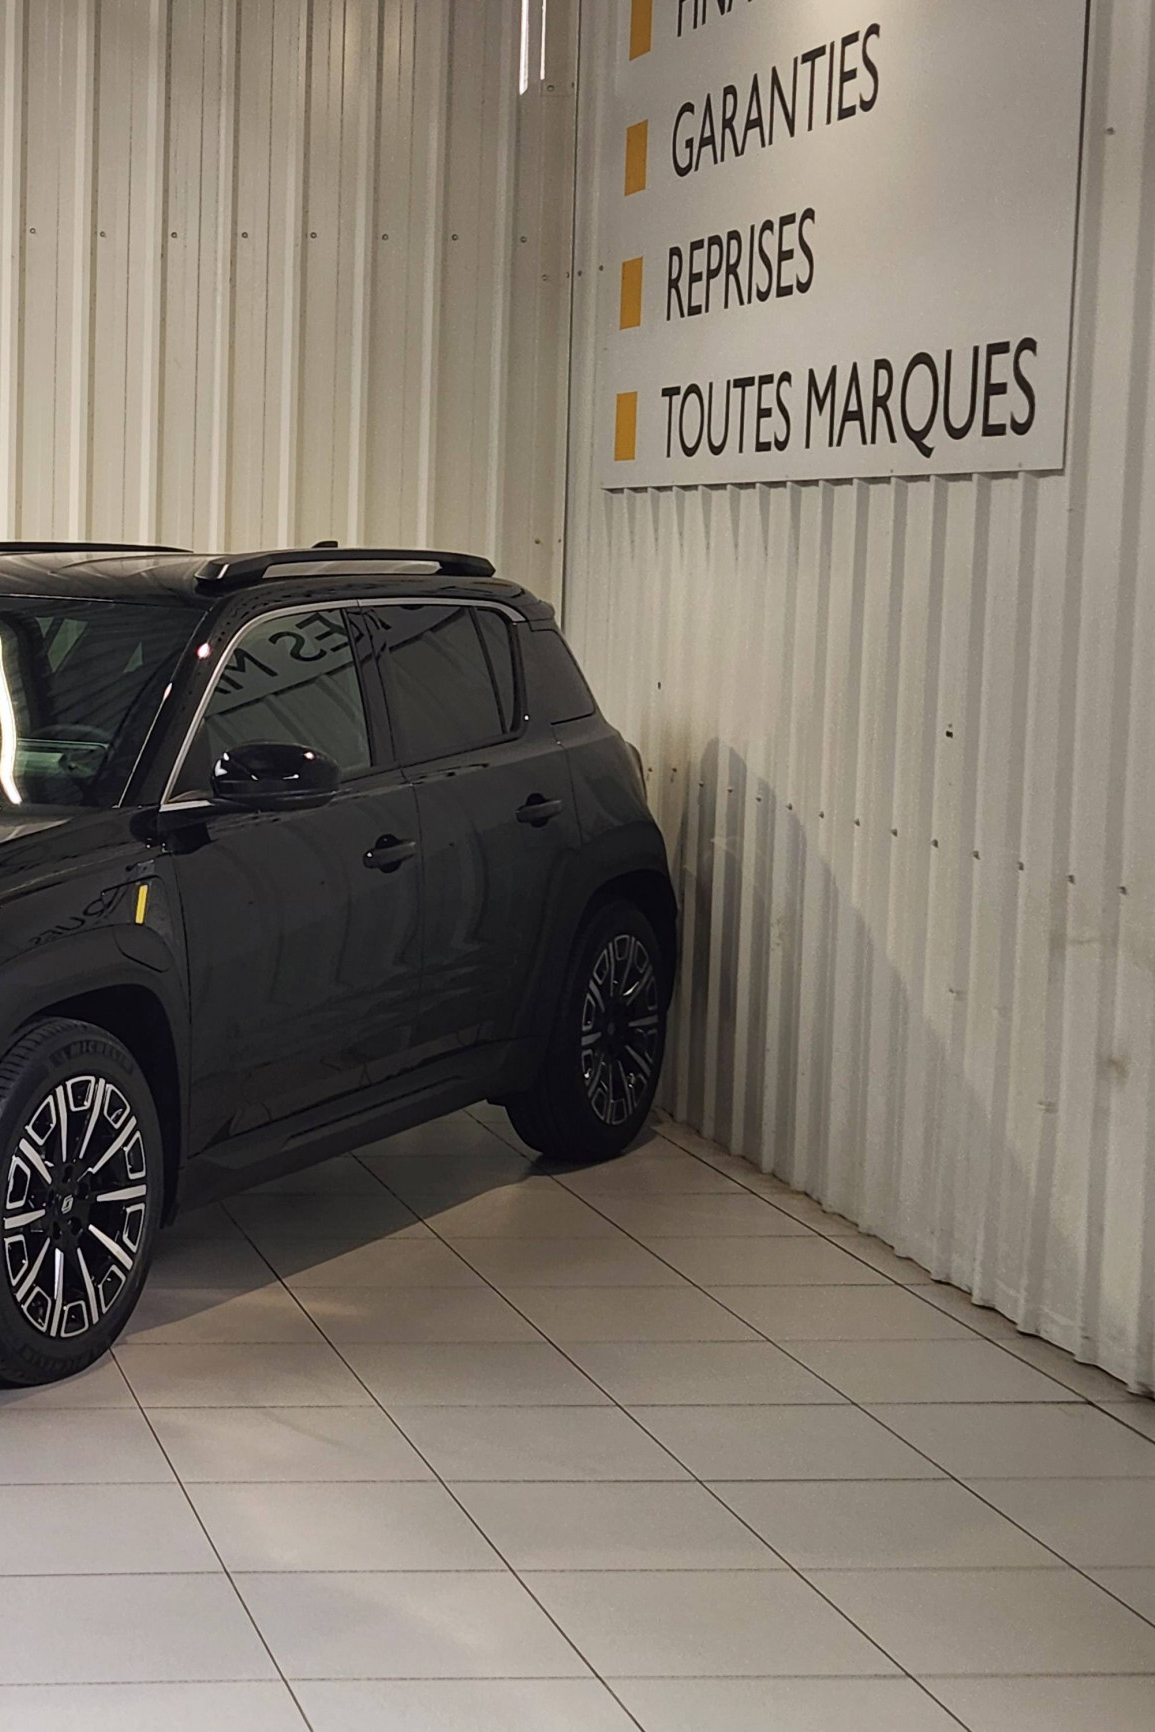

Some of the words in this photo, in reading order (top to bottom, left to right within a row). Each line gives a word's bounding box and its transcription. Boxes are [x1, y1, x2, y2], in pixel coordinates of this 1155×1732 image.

[671, 23, 881, 177] GARANTIES
[665, 207, 816, 322] REPRISES
[661, 371, 792, 458] TOUTES
[804, 337, 1038, 459] MARQUES
